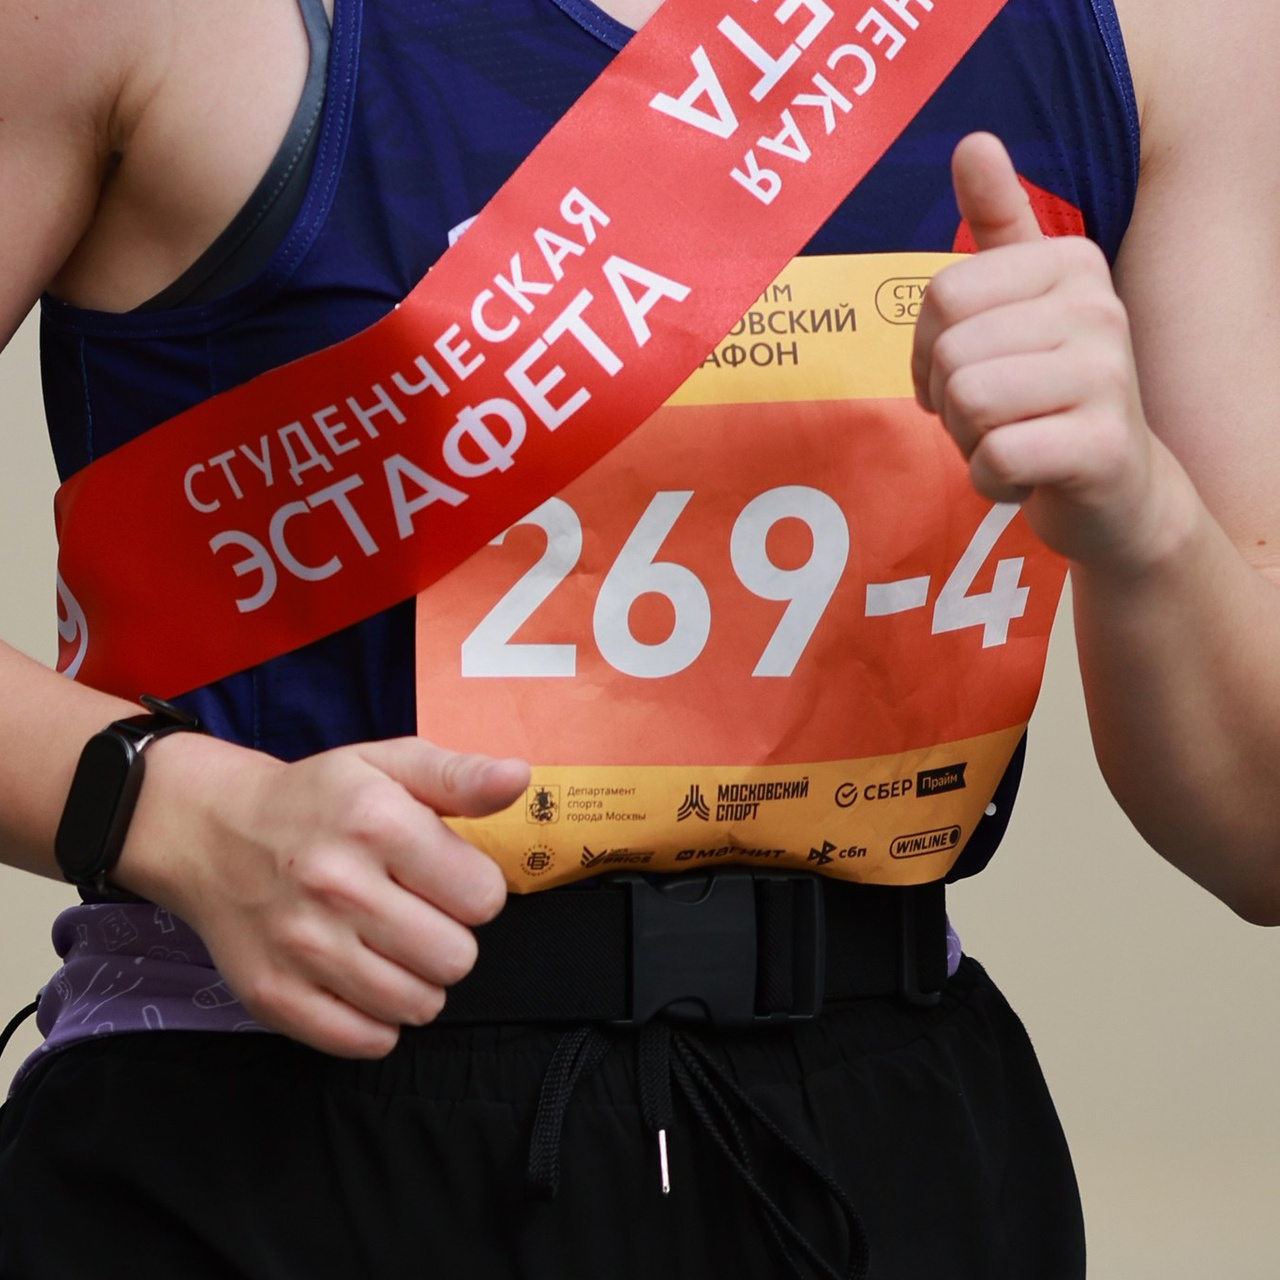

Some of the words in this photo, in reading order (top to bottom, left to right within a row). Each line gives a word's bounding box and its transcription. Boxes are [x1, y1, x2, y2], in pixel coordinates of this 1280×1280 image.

[728, 302, 857, 337] ОВСКИЙ
[182, 186, 611, 514] СТУДЕНЧЕСКАЯ
[698, 341, 799, 369] АФОН
[208, 253, 692, 614] ЭСТАФЕТА
[460, 484, 1030, 679] 269-4
[567, 786, 636, 797] Департамент
[717, 775, 810, 803] МОСКОВСКИЙ
[863, 778, 913, 801] СБЕР
[922, 771, 959, 791] Прайм
[567, 800, 603, 810] спорта
[567, 812, 603, 822] города
[605, 811, 647, 821] Москвы
[716, 803, 760, 822] СПОРТ
[895, 832, 949, 854] WINLINE
